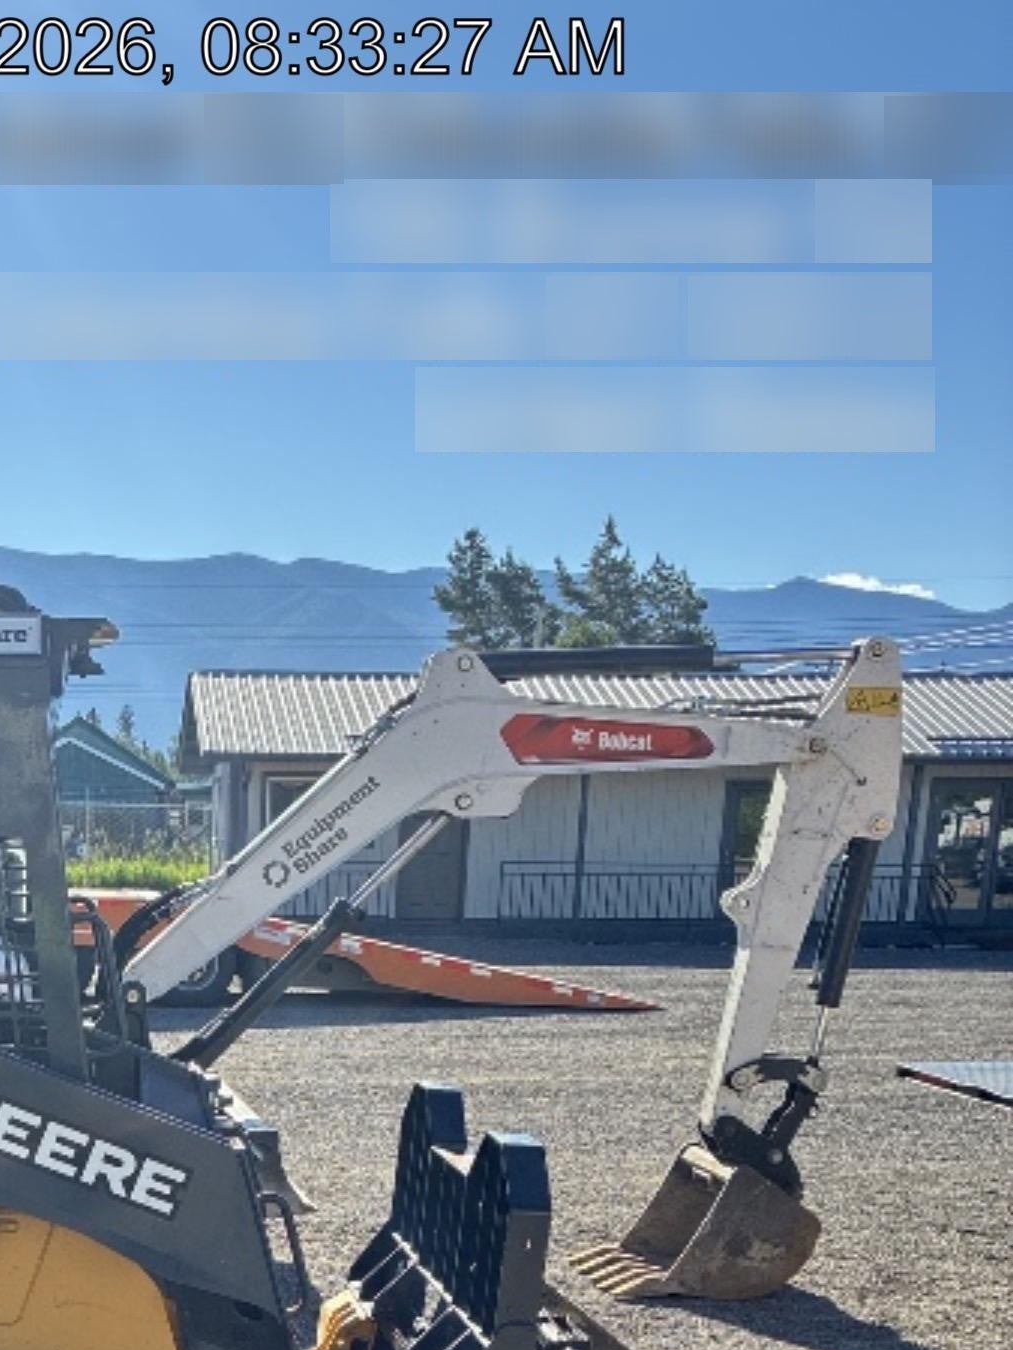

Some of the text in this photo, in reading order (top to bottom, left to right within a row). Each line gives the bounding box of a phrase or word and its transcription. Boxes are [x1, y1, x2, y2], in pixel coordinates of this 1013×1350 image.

[598, 731, 652, 751] Bobcat
[280, 776, 380, 858] Equipment
[292, 827, 348, 874] Share
